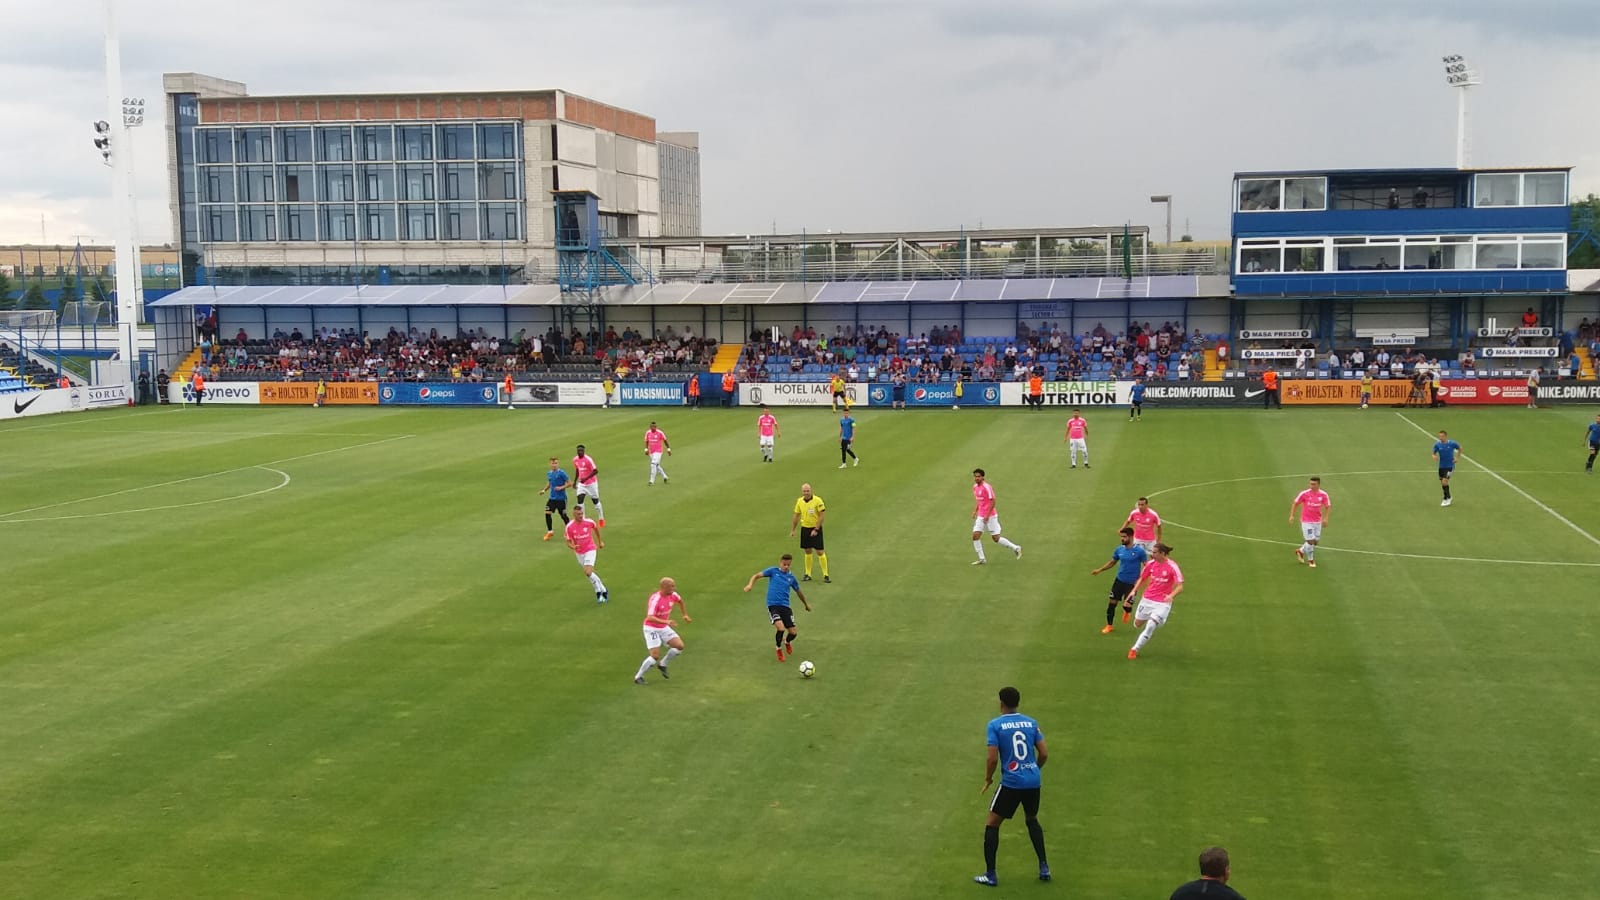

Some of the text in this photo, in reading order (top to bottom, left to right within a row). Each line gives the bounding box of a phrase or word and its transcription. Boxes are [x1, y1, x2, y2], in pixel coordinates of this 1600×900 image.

[88, 389, 125, 400] SORLA
[201, 387, 250, 400] synevo
[278, 387, 309, 399] HOLSTEN
[340, 387, 359, 399] BERII
[431, 390, 455, 399] pepsi
[622, 388, 633, 399] NU
[774, 384, 808, 394] HOTEL
[1145, 386, 1236, 398] NIKE.COM/FOOTBALL
[1305, 385, 1343, 398] HOLSTEN
[1383, 385, 1407, 398] BERII
[928, 390, 954, 400] pepsi
[1001, 721, 1033, 730] HOLSTEN
[1012, 731, 1028, 761] 6
